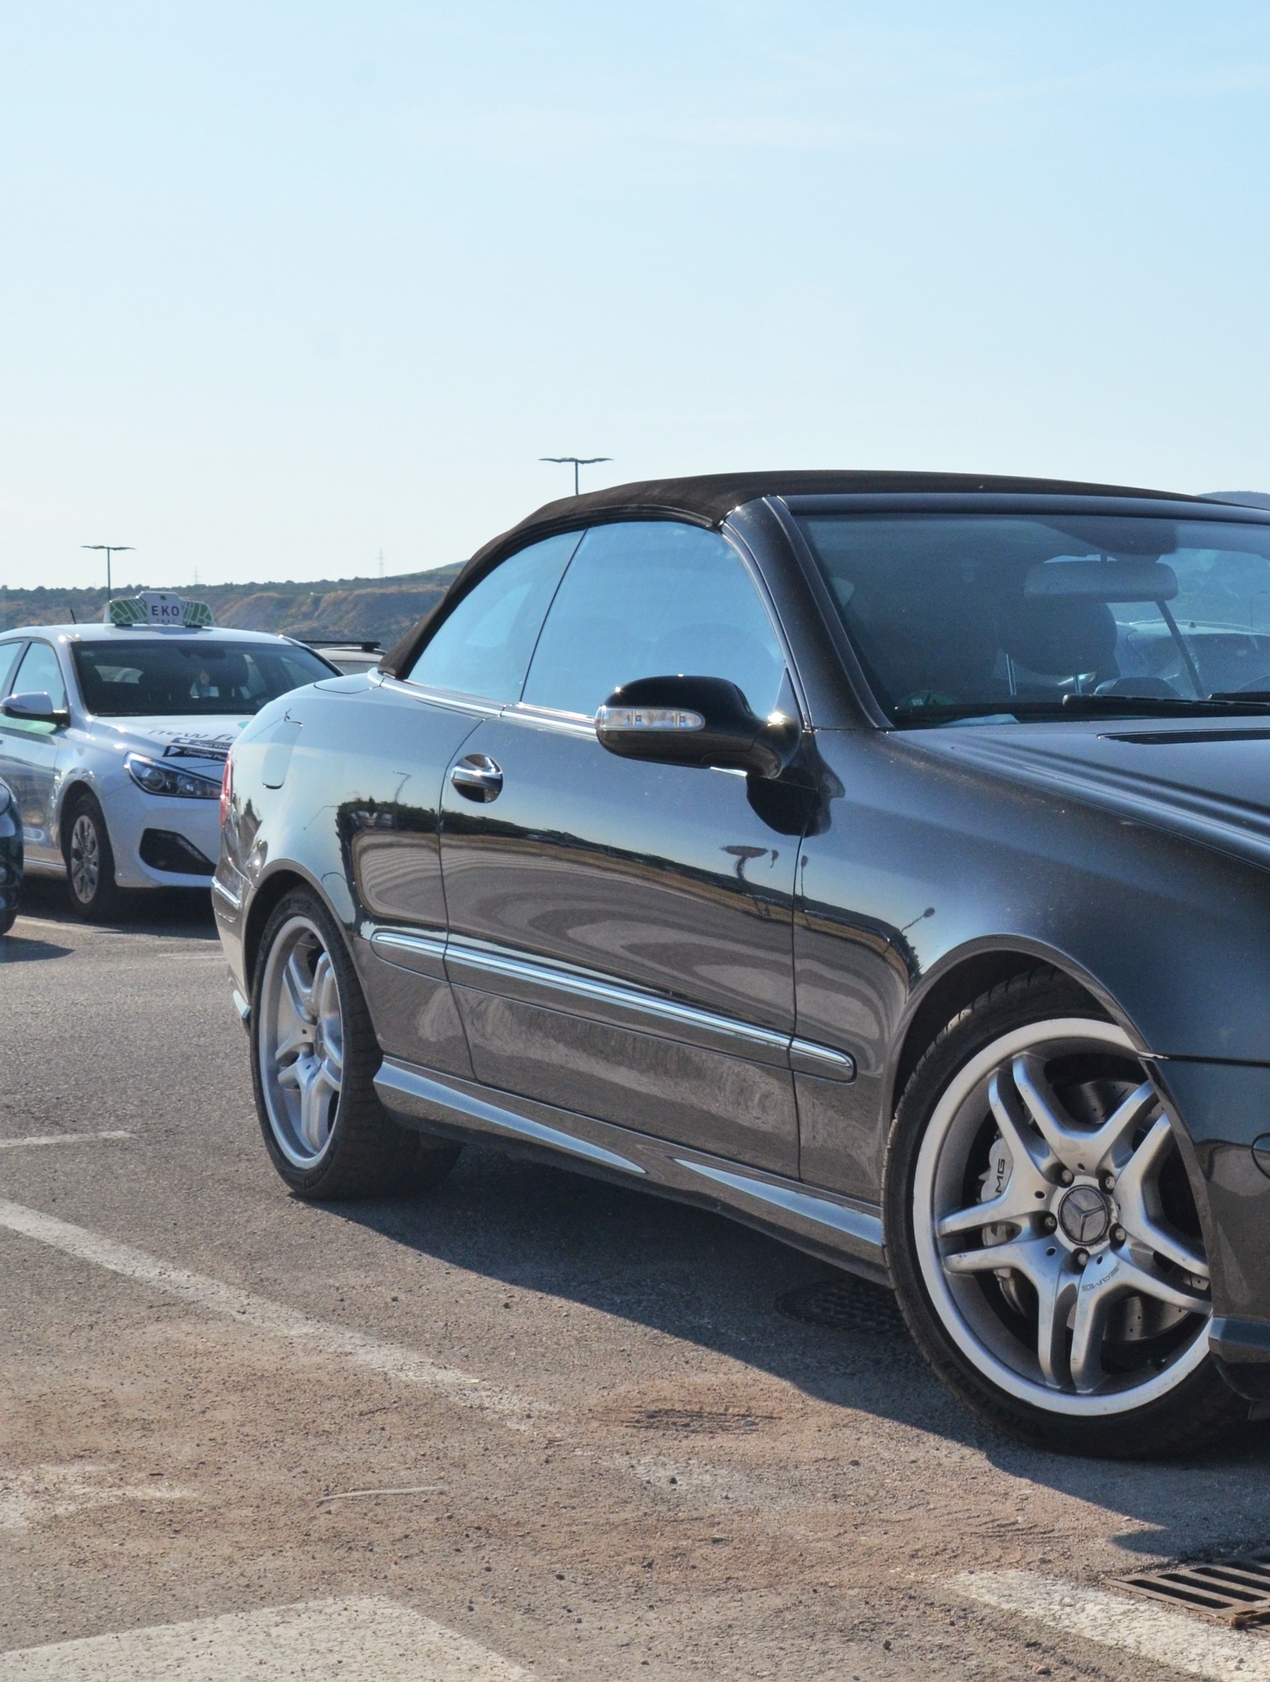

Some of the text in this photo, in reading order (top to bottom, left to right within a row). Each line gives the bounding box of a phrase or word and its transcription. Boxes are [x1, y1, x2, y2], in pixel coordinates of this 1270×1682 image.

[151, 605, 180, 617] EKO
[148, 730, 208, 738] new
[184, 750, 213, 759] Google
[995, 1158, 1006, 1194] MG
